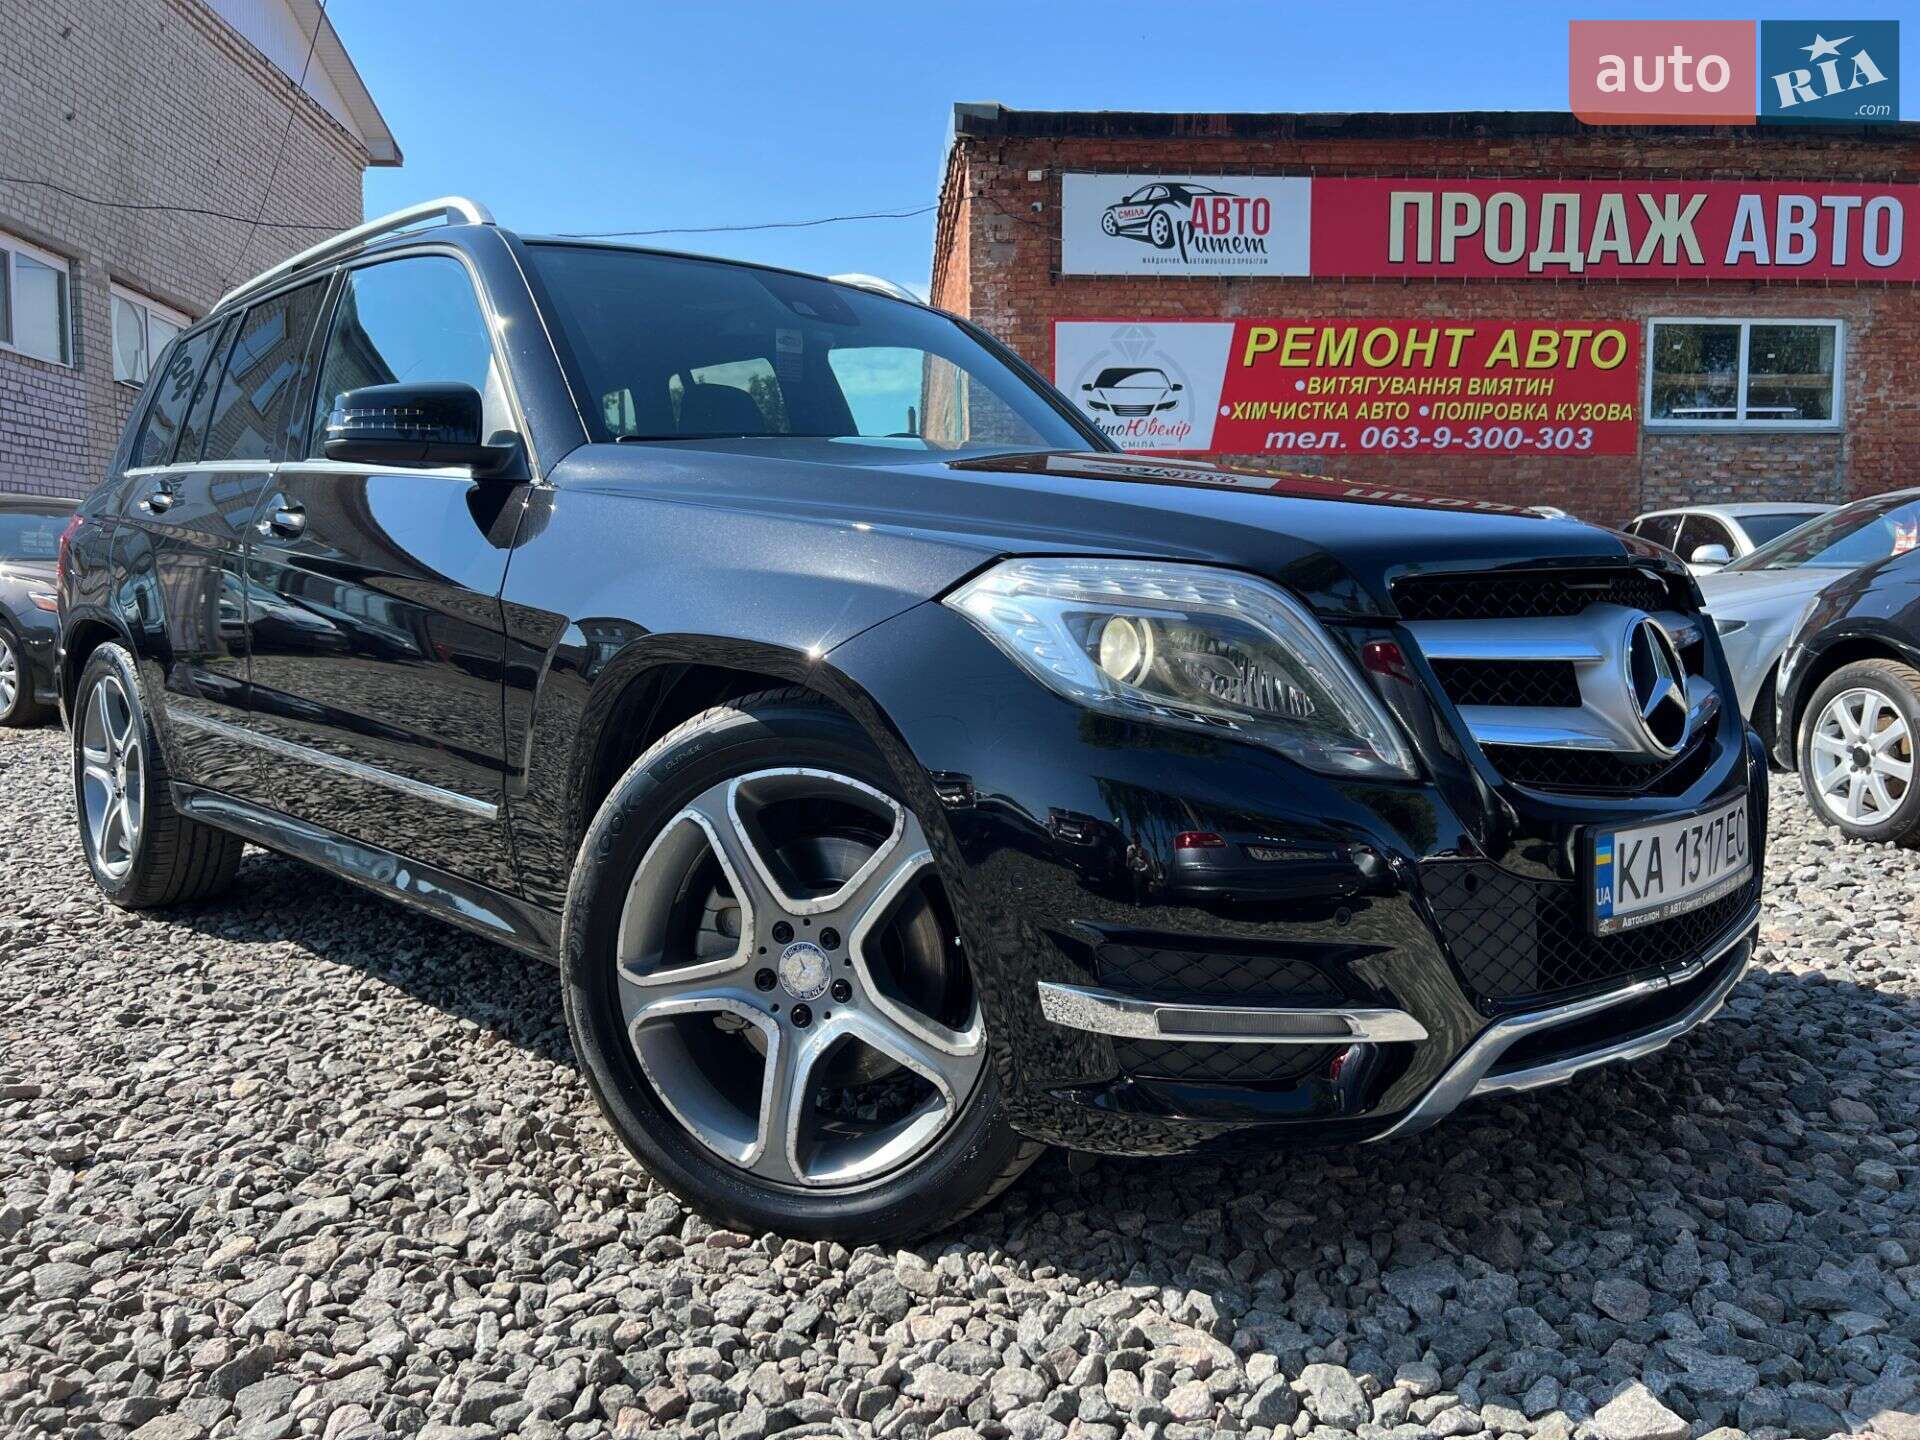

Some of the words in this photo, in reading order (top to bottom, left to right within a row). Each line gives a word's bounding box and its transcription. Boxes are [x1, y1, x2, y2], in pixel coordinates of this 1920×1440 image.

[1191, 197, 1271, 235] АВТО
[1388, 191, 1708, 273] ПРОДАЖ
[1723, 194, 1905, 267] АВТО
[1243, 327, 1475, 369] РЕМОНТ
[1484, 329, 1628, 370] АВТО
[1307, 376, 1462, 395] ВИТЯГУВАННЯ
[1467, 377, 1555, 396] ВМЯТИН
[1231, 401, 1349, 420] ХІМЧИСТКА
[1355, 402, 1410, 420] АВТО
[1431, 402, 1550, 421] ПОЛІРОВКА
[1555, 403, 1634, 421] КУЗОВА
[1265, 431, 1347, 449] тел.
[1360, 426, 1594, 450] 063-9-300-303
[1618, 836, 1664, 904] KA
[1595, 886, 1612, 906] UA
